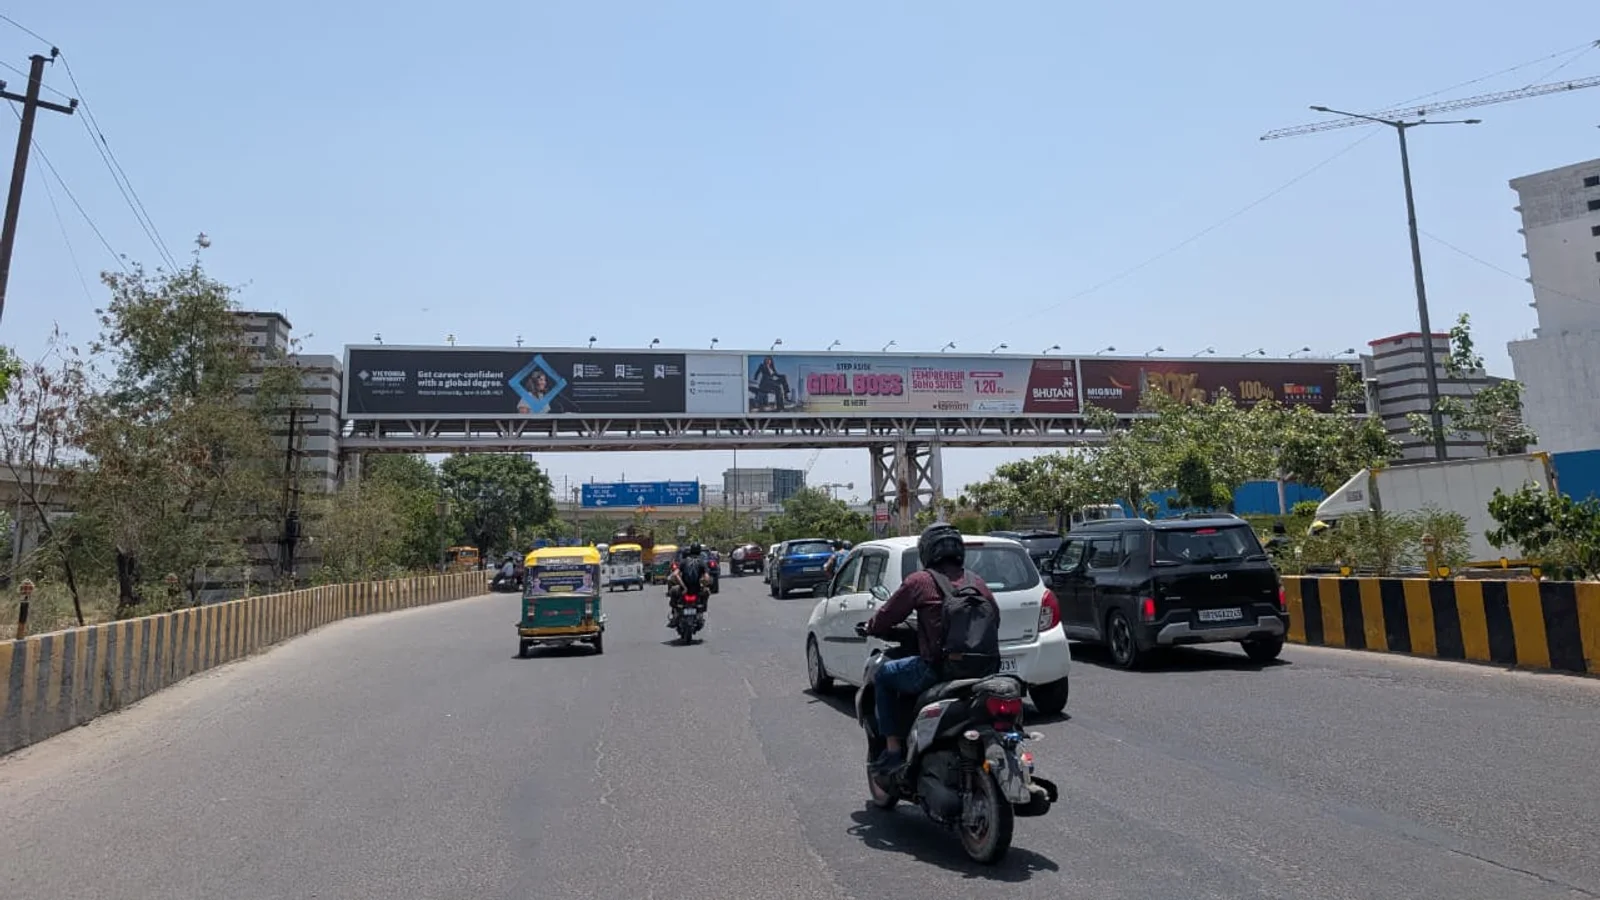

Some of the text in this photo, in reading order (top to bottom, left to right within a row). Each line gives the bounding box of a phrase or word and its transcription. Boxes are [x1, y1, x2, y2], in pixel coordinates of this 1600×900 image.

[444, 379, 471, 388] global
[472, 379, 504, 388] degree.
[807, 373, 903, 396] GIRL BOSS
[935, 380, 962, 388] SUITES
[974, 380, 995, 393] 1.20
[1032, 388, 1074, 398] BHUTANI
[1239, 381, 1274, 399] 100%
